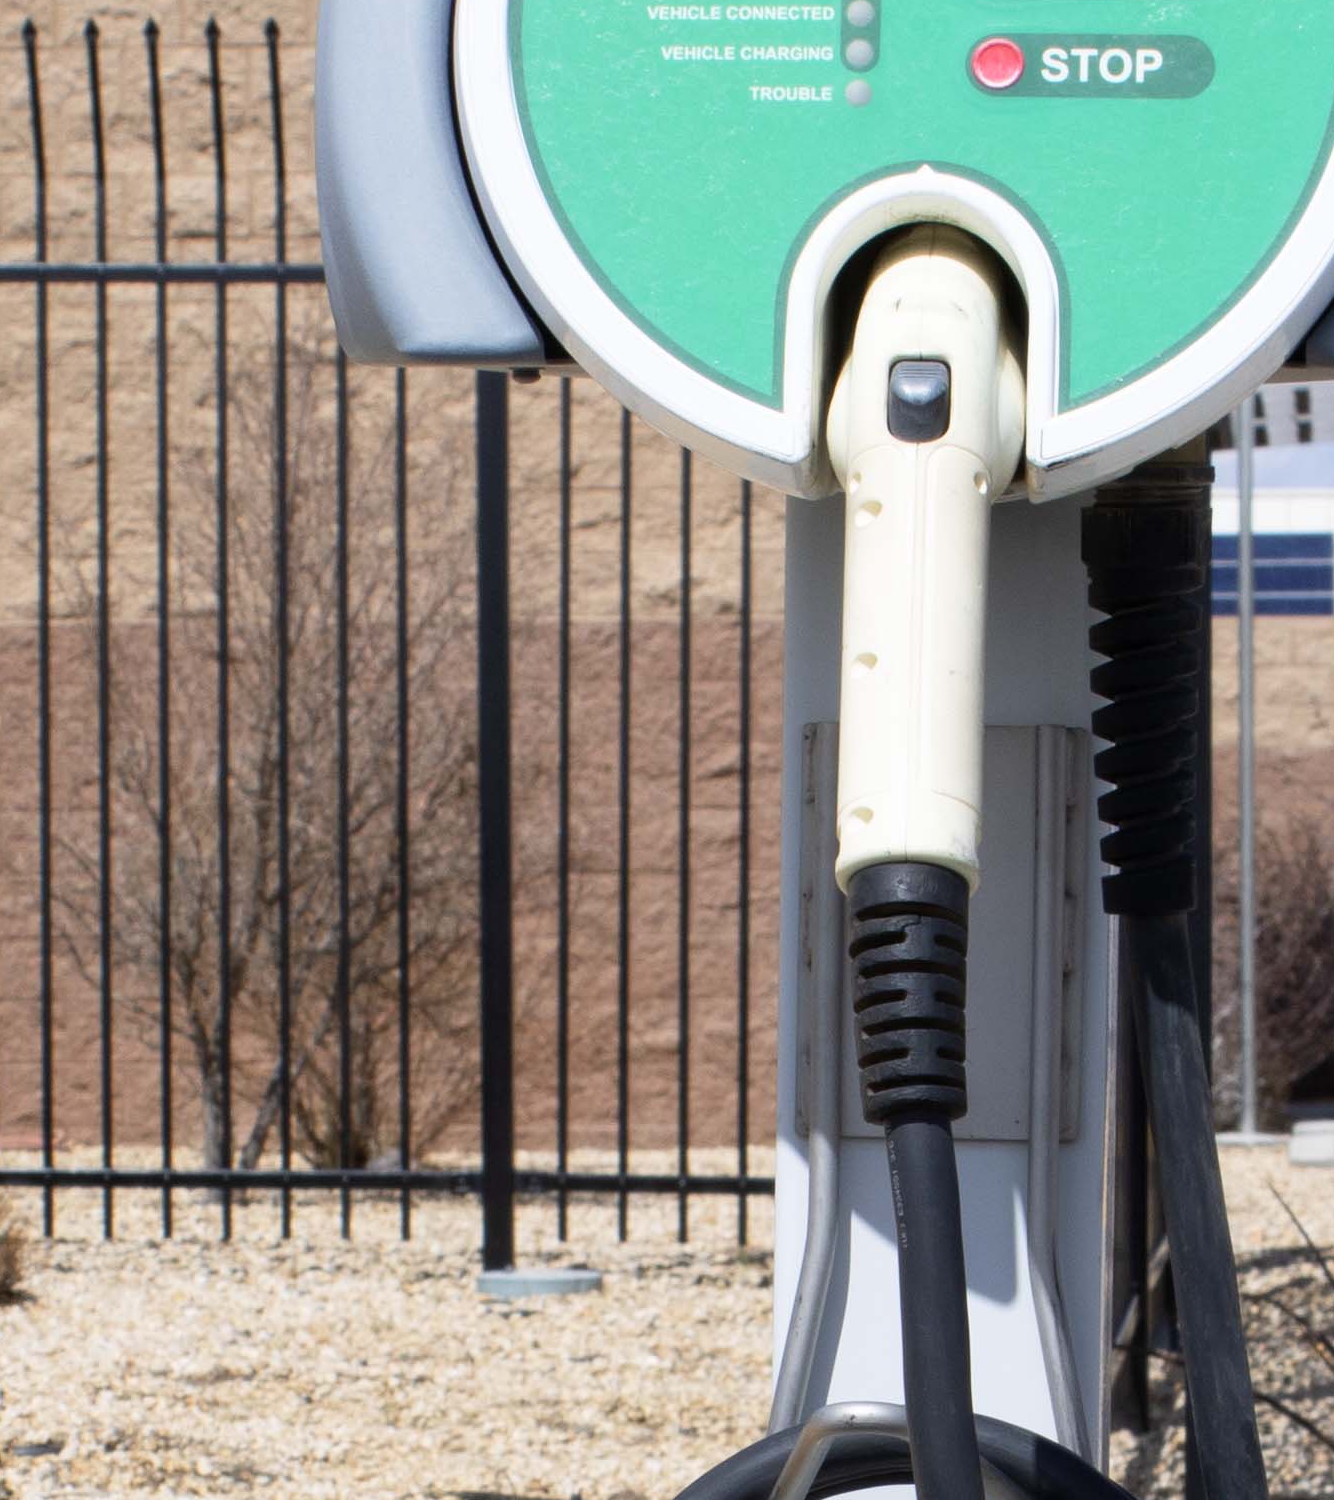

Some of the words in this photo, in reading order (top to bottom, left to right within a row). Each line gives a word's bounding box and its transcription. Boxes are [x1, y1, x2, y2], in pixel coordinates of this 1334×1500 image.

[647, 6, 721, 20] VEHICLE
[726, 6, 835, 20] CONNECTED
[661, 46, 735, 60] VEHICLE
[740, 46, 834, 60] CHARGING
[1041, 47, 1163, 83] STOP
[750, 86, 832, 100] TROUBLE
